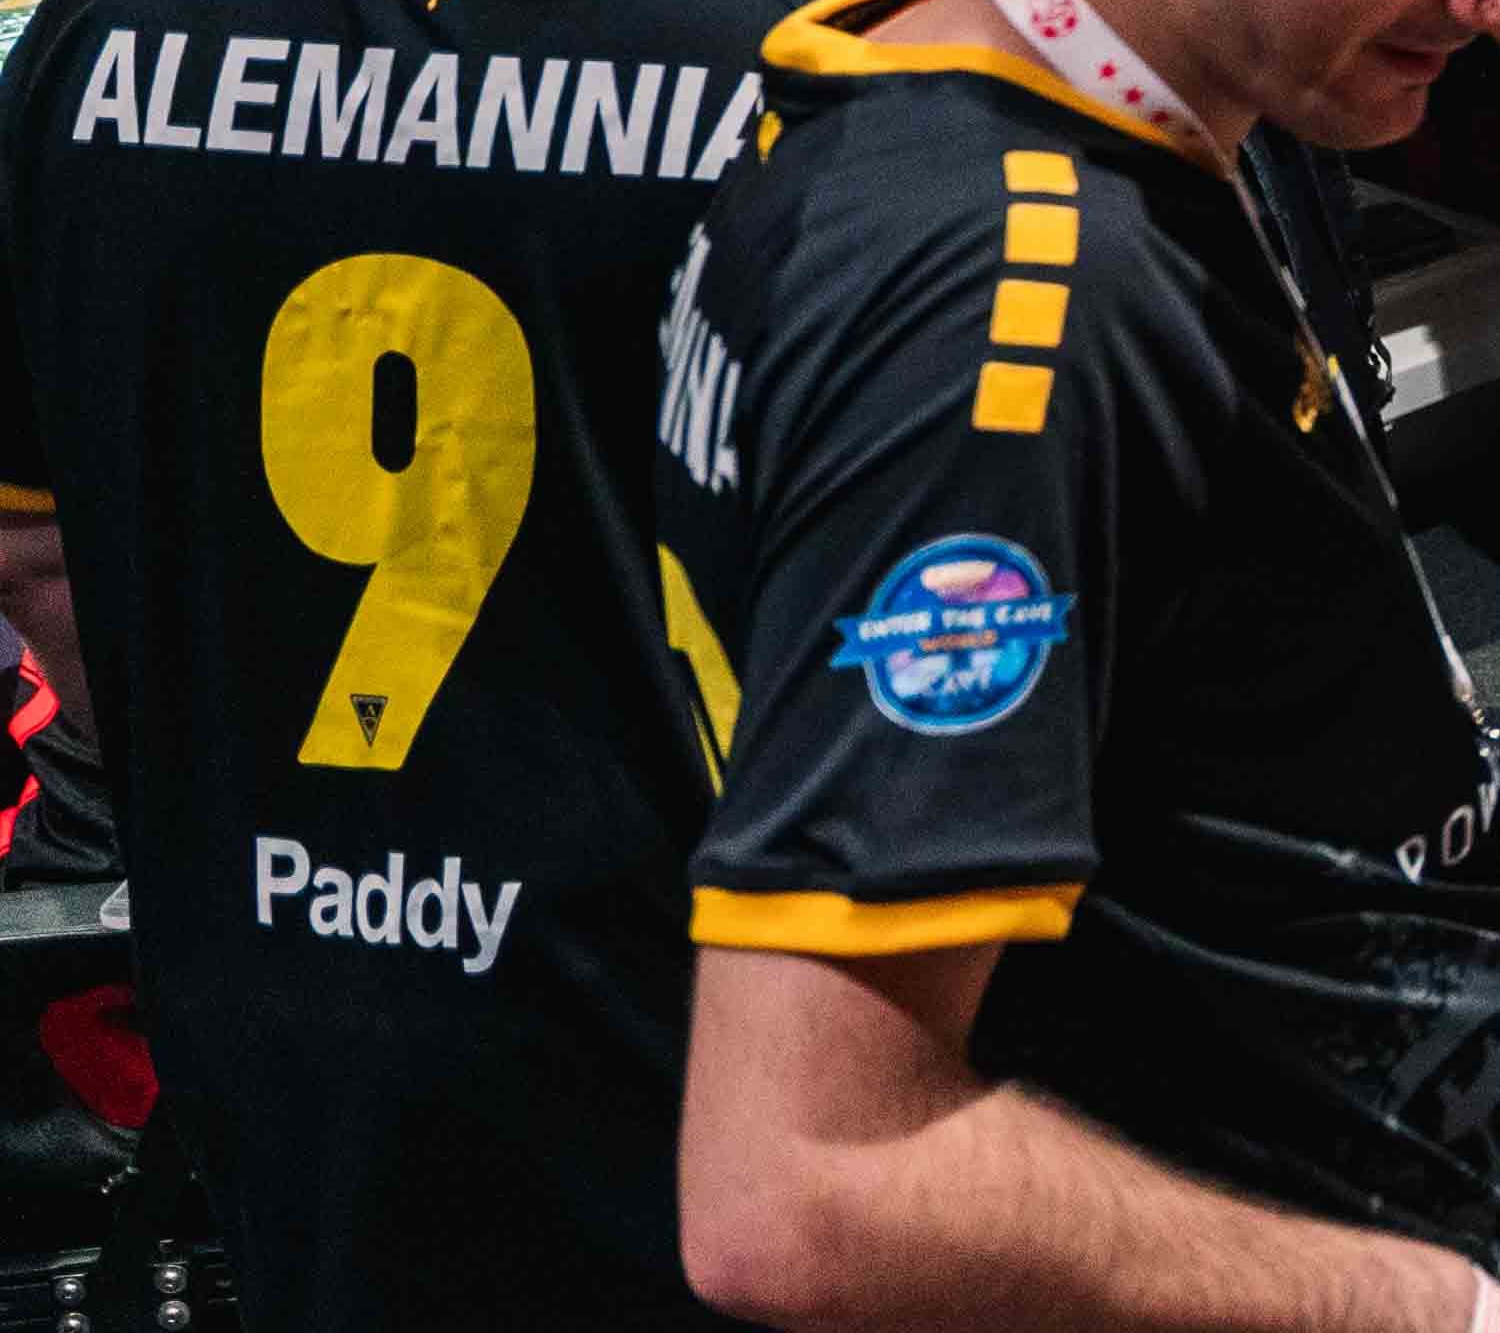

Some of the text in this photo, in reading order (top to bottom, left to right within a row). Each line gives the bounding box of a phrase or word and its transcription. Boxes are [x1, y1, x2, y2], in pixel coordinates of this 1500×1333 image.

[72, 27, 764, 183] ALEMANNIA
[260, 253, 536, 771] 9
[255, 835, 523, 974] Paddy
